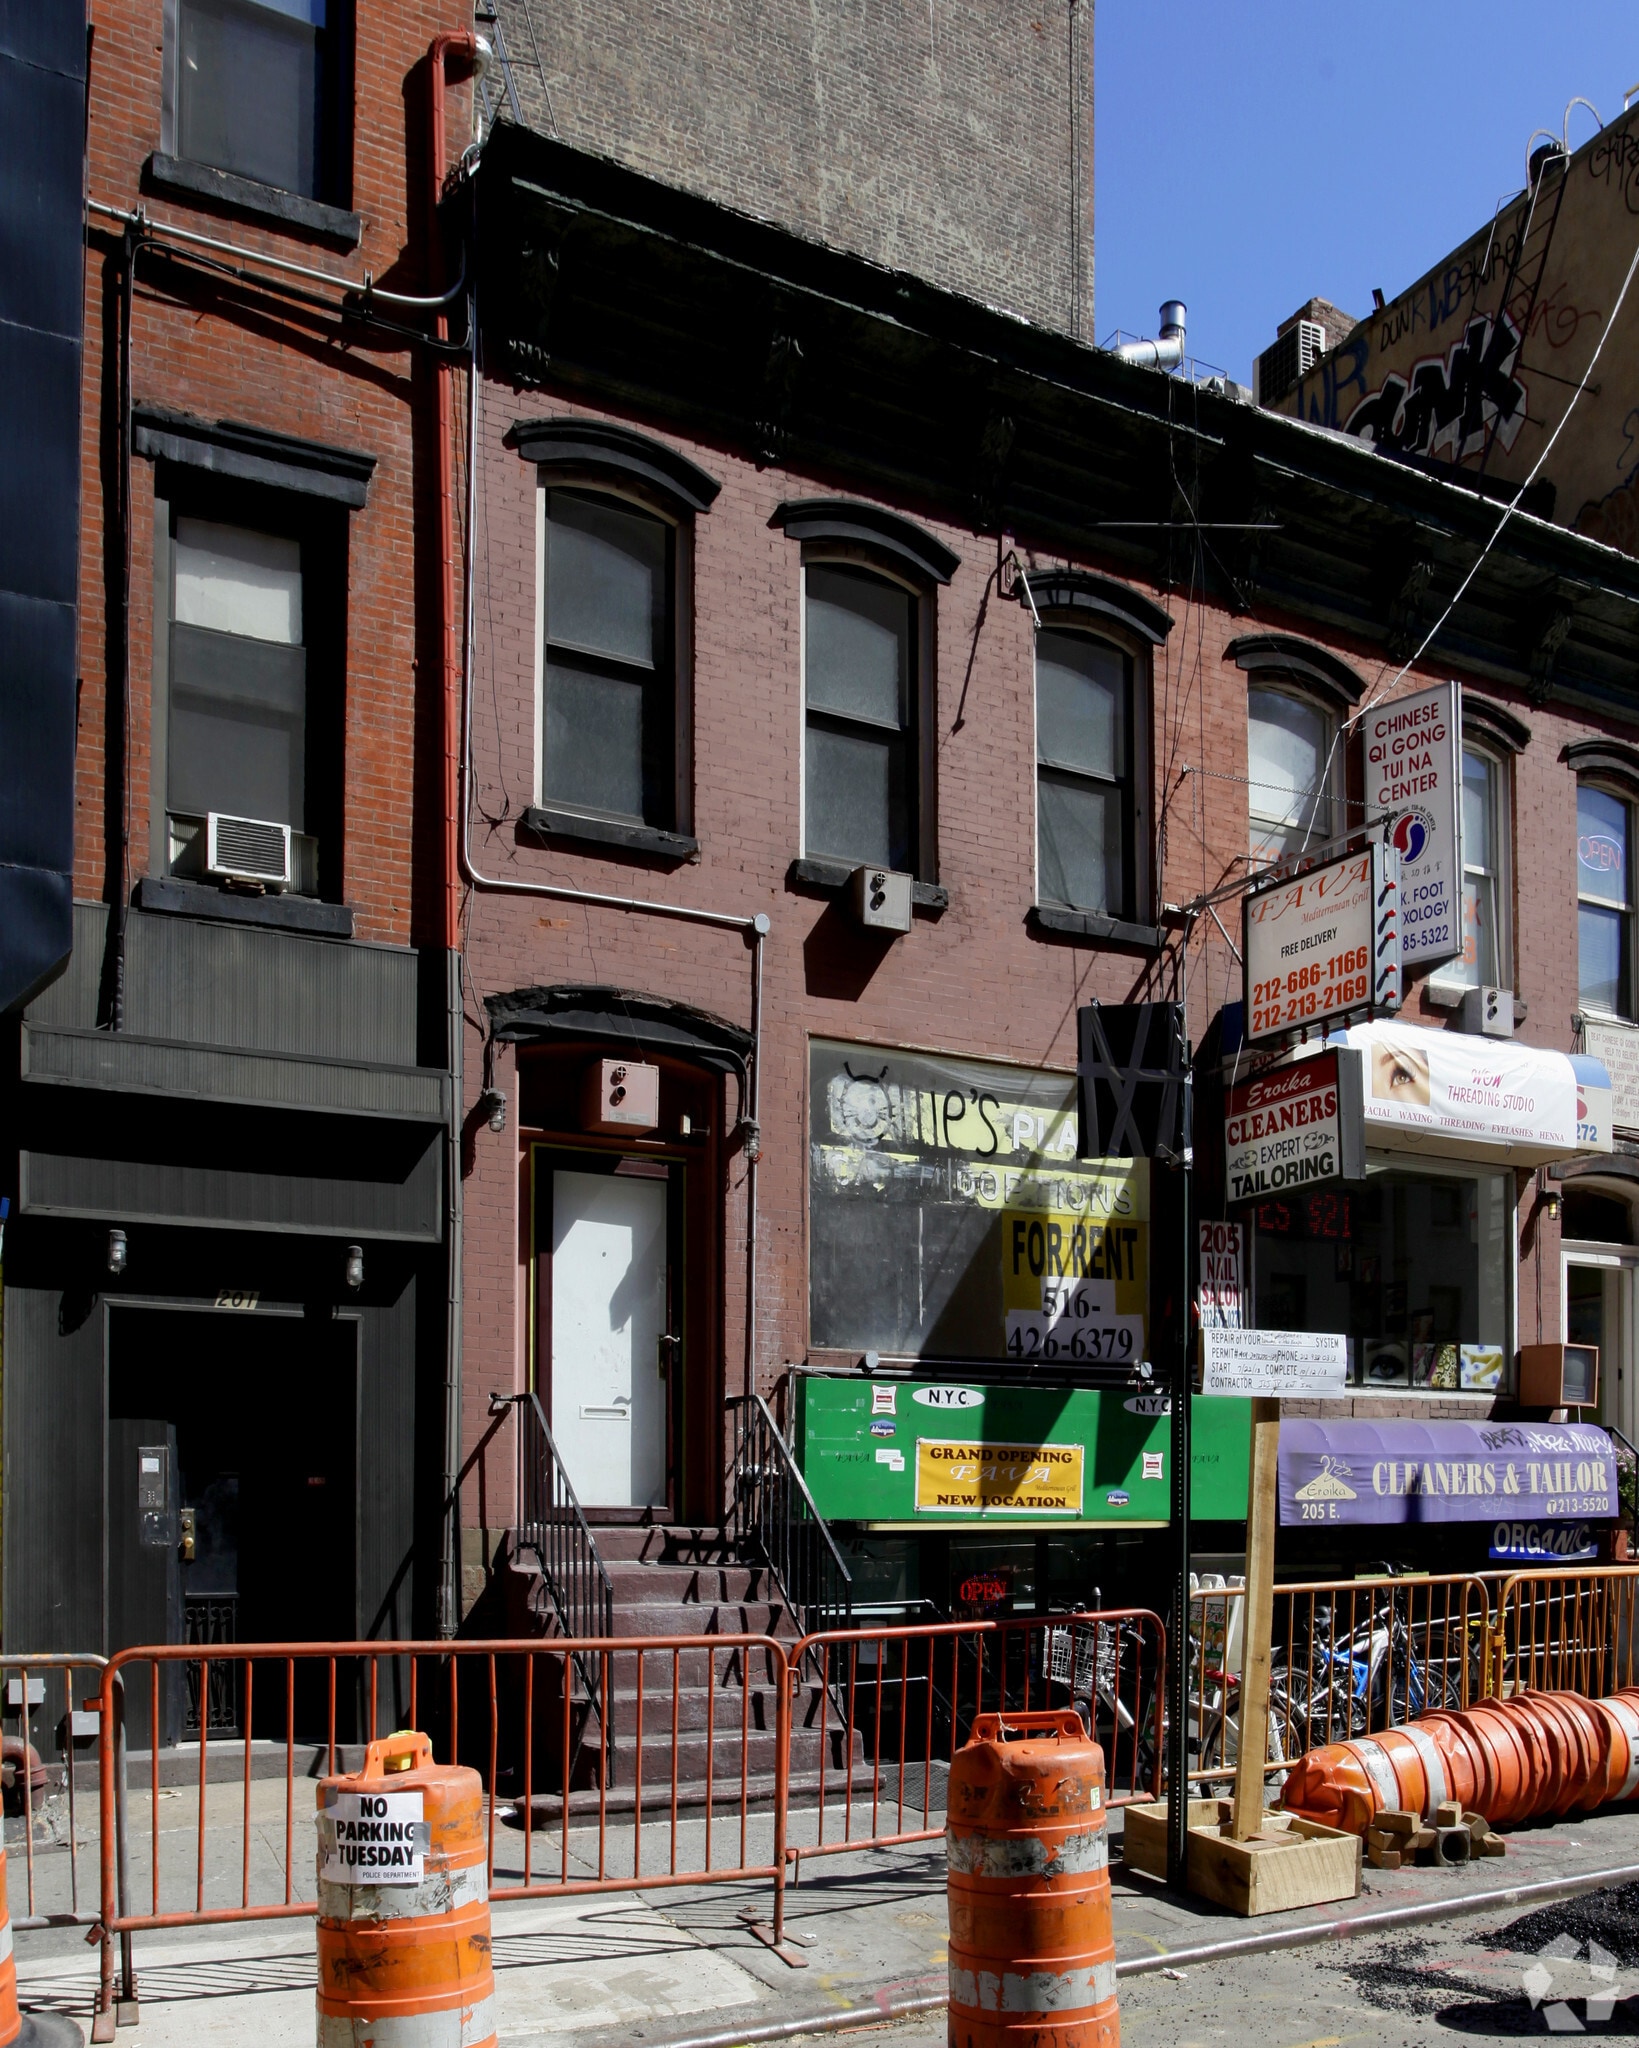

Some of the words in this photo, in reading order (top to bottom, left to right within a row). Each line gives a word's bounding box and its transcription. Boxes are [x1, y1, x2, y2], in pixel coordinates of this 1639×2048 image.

[1374, 701, 1440, 739] CHINESE
[1368, 742, 1387, 763] QI
[1391, 723, 1446, 756] GONG
[1382, 759, 1404, 782] TUI
[1408, 751, 1433, 774] NA
[1378, 771, 1438, 805] CENTER
[1577, 835, 1621, 871] OPEN
[1250, 856, 1372, 926] FAVA
[1413, 880, 1445, 903] FOOT
[1301, 899, 1350, 926] Mediterranean
[1352, 886, 1370, 910] Grill
[1280, 940, 1299, 959] FREE
[1301, 926, 1338, 951] DELIVERY
[1253, 945, 1368, 1007] 212-686-1166
[1252, 974, 1367, 1033] 212-213-2169
[1246, 1070, 1312, 1108] Eroika
[1448, 1085, 1500, 1108] THREADING
[1502, 1094, 1535, 1113] STUDIO
[1226, 1090, 1337, 1147] CLEANERS
[1363, 1104, 1393, 1119] FACIAL
[1399, 1110, 1433, 1125] WAXING
[1439, 1116, 1486, 1131] THREADING
[1491, 1124, 1534, 1138] EYELASHES
[1539, 1130, 1565, 1142] HENNA
[1260, 1136, 1301, 1165] EXPERT
[1231, 1151, 1334, 1199] TAILORING
[1012, 1220, 1064, 1278] FOR
[1072, 1223, 1138, 1282] RENT
[1200, 1224, 1240, 1255] 205
[1206, 1255, 1235, 1281] NAIL
[217, 1290, 255, 1308] 201
[1042, 1286, 1101, 1319] 516-
[1201, 1281, 1242, 1307] SALON
[1007, 1326, 1133, 1359] 426-6379
[1211, 1332, 1235, 1345] REPAIR
[1236, 1333, 1242, 1343] of
[1243, 1334, 1261, 1345] YOUR
[1315, 1337, 1339, 1349] SYSTEM
[1211, 1347, 1239, 1359] PERMIT#
[1277, 1350, 1298, 1362] PHONE
[1210, 1376, 1253, 1389] CONTRACTOR
[1211, 1362, 1231, 1373] START
[1265, 1364, 1298, 1376] COMPLETE
[928, 1389, 970, 1405] N.Y.C.
[930, 1447, 993, 1462] GRAND
[997, 1449, 1073, 1464] OPENING
[950, 1464, 1051, 1484] FAVA
[1372, 1462, 1496, 1496] CLEANERS
[1503, 1462, 1521, 1495] &
[1526, 1461, 1608, 1494] TAILOR
[937, 1494, 977, 1506] NEW
[982, 1495, 1066, 1507] LOCATION
[1306, 1482, 1346, 1497] Eroika
[1302, 1503, 1325, 1519] 205
[1329, 1503, 1340, 1519] E.
[1558, 1497, 1609, 1513] 213-5520
[1493, 1521, 1592, 1555] ORGANIC
[960, 1581, 1006, 1600] OPEN
[360, 1797, 388, 1818] NO
[336, 1820, 414, 1842] PARKING
[338, 1843, 414, 1866] TUESDAY
[362, 1871, 381, 1879] POLICE
[383, 1871, 420, 1879] DEPARTMENT
